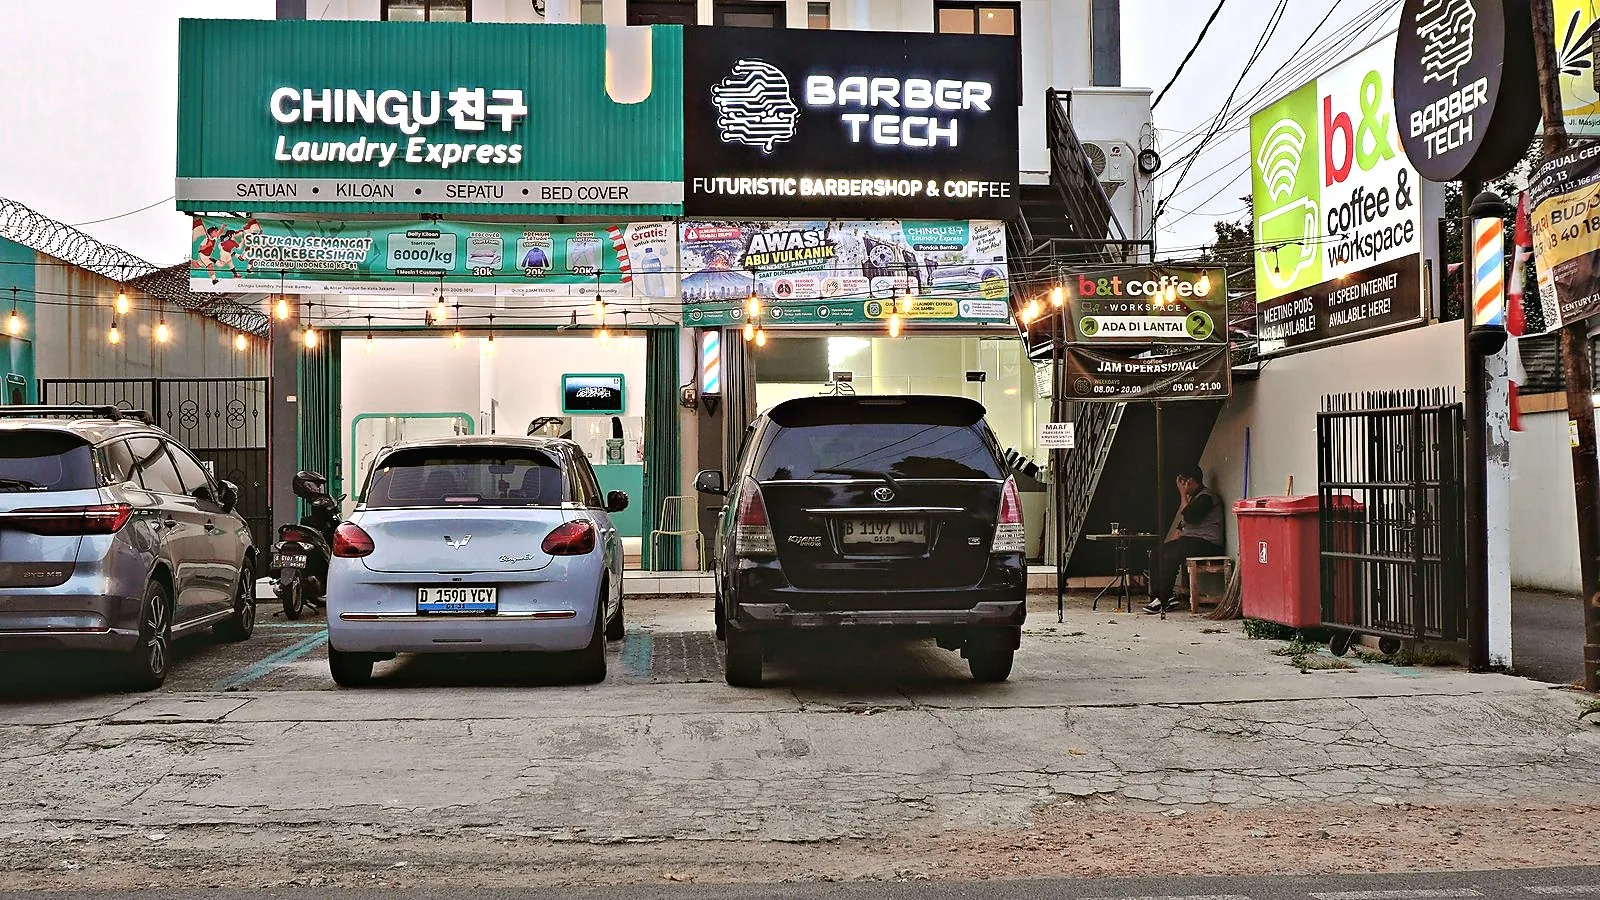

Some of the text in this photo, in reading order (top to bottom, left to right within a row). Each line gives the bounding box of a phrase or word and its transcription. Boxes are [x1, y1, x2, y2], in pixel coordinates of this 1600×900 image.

[806, 75, 992, 111] BARBER
[269, 87, 528, 135] CHINGU 친구
[1410, 76, 1488, 138] BARBER
[841, 113, 958, 147] TECH
[1322, 69, 1405, 187] b&
[1423, 114, 1473, 160] TECH
[274, 135, 523, 168] Laundry Express
[1556, 170, 1568, 181] 13
[236, 182, 629, 201] SATUAN KILOAN SEPATU BED COVER
[693, 176, 1011, 199] FUTURISTIC BARBERSHOP & COFFEE
[1327, 167, 1413, 236] coffee &
[244, 234, 372, 250] SATUKAN SEMANGAT
[631, 228, 668, 240] Gratis!
[907, 227, 947, 236] CHINGU
[747, 230, 826, 255] AWAS!
[1327, 218, 1414, 268] workspace
[246, 247, 366, 261] JAGA KEBERSIHAN
[393, 247, 452, 264] 6000/kg
[744, 245, 834, 267] ABU VULKANIK
[252, 260, 295, 269] DIRGAHAYU
[296, 261, 335, 270] INDONESIA
[473, 267, 493, 276] 30k
[1078, 274, 1209, 297] b&t coffee
[1328, 272, 1398, 307] HI SPEED INTERNET
[1109, 303, 1182, 313] WORKSPACE
[1263, 296, 1314, 323] MEETING PODS
[1329, 297, 1391, 327] AVAILABLE HERE!
[1561, 295, 1592, 312] CENTURY
[1101, 315, 1206, 335] ADA DI LANTAI 2
[1263, 315, 1316, 340] ARE AVAILABLE!
[1097, 360, 1199, 374] JAM OPERASIONAL
[1093, 385, 1115, 394] 08.00
[1120, 385, 1142, 394] 20.00
[1172, 383, 1194, 393] 09.00
[1199, 382, 1222, 391] 21.00
[846, 519, 923, 535] B 1197 UVL
[419, 589, 494, 604] D 1590 YCY
